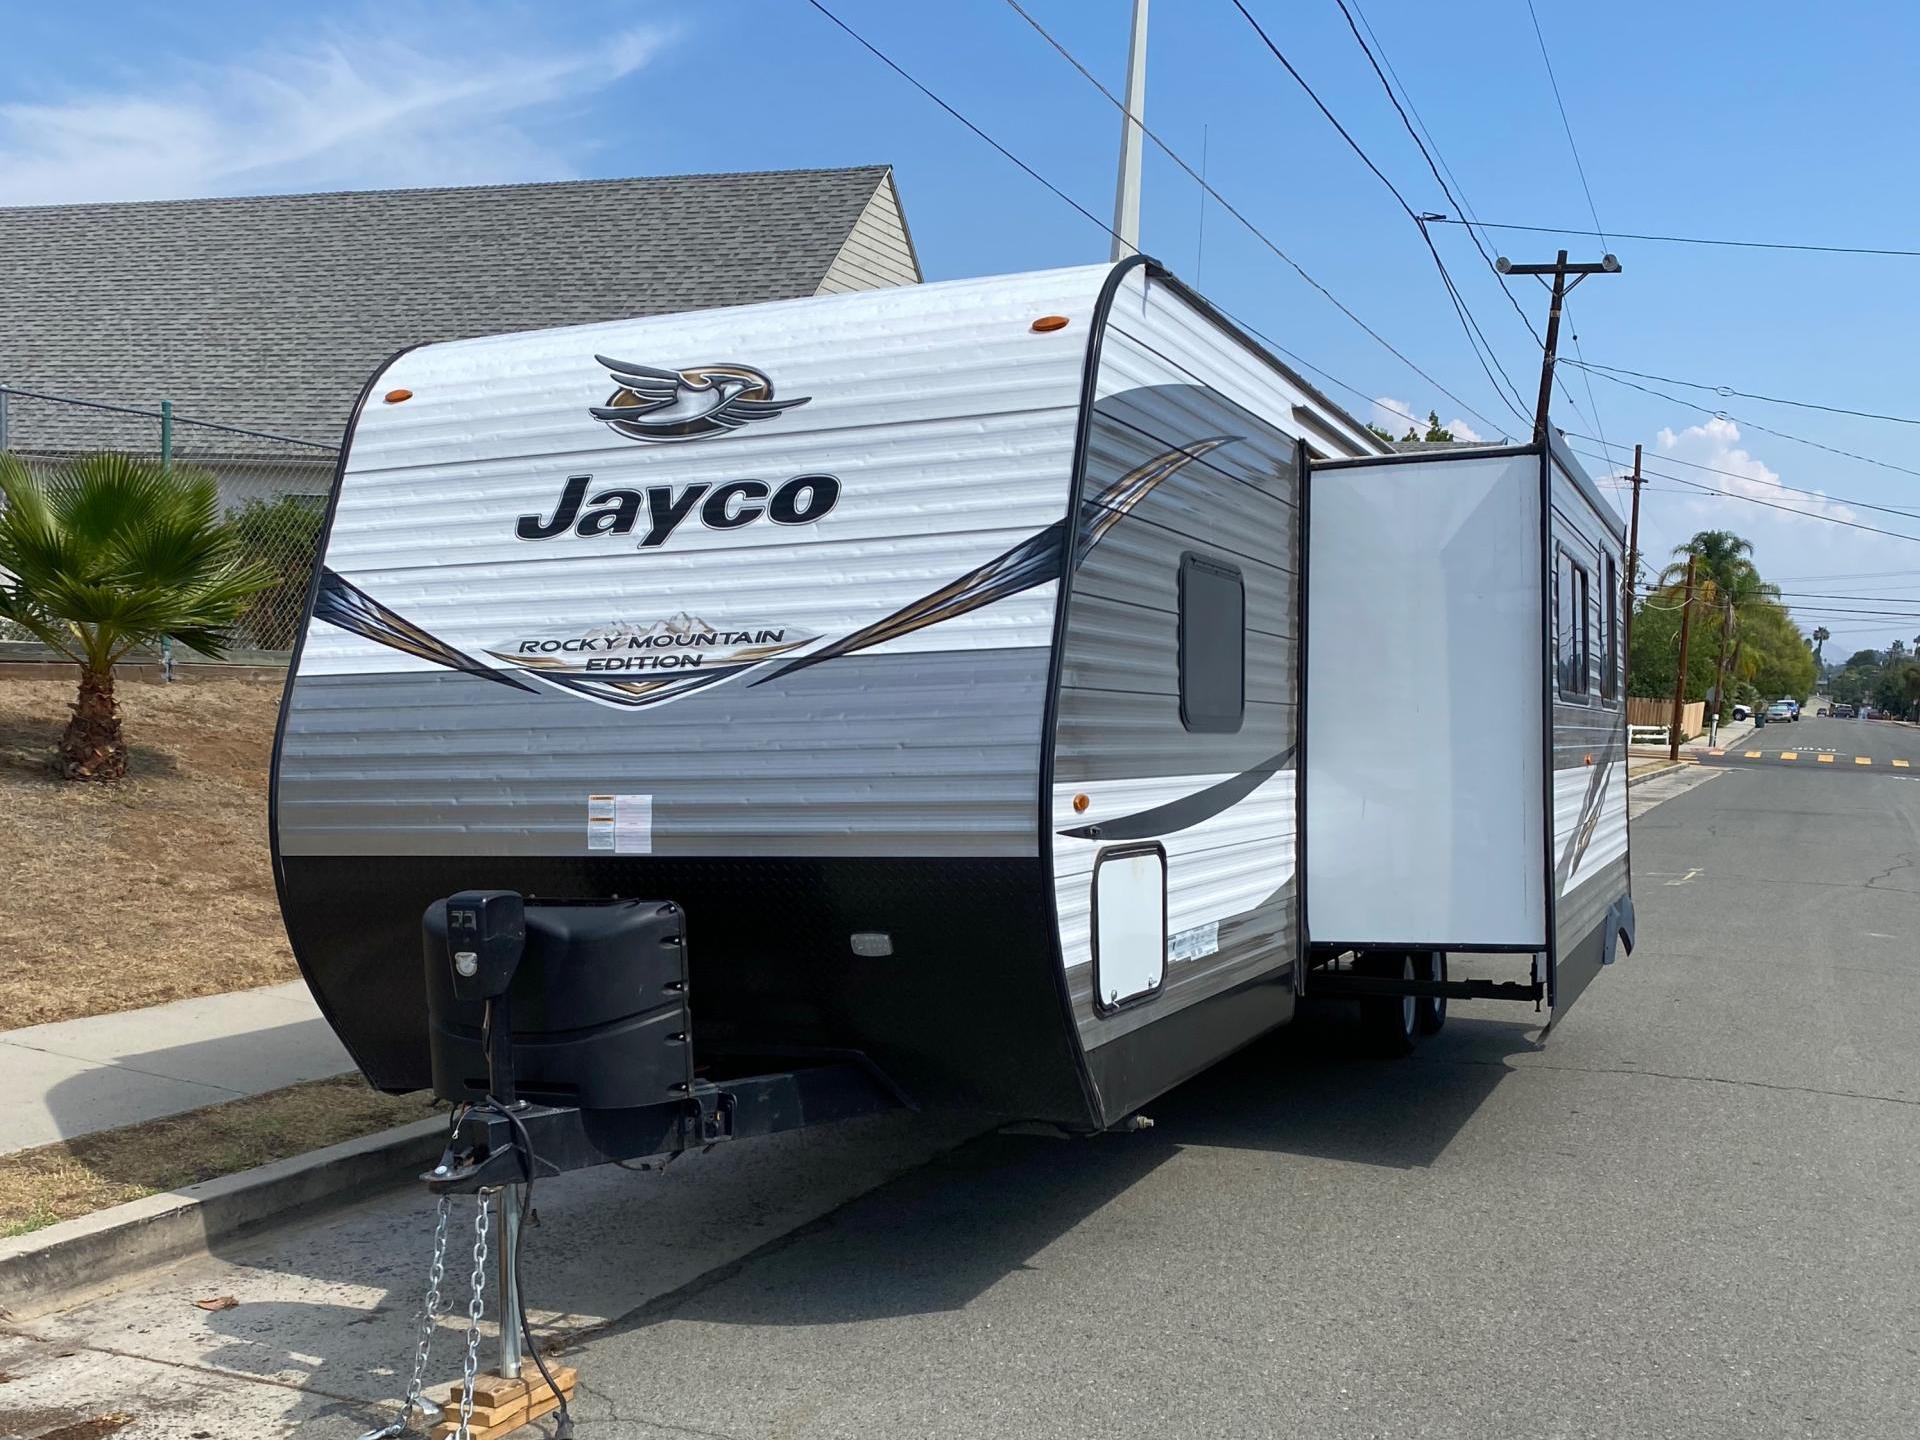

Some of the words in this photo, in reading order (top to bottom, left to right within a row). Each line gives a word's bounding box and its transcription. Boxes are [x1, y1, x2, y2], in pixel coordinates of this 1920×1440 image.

[516, 474, 842, 549] Jayco
[518, 636, 621, 654] ROCKY
[629, 630, 785, 649] MOUNTAIN
[585, 655, 704, 671] EDITION
